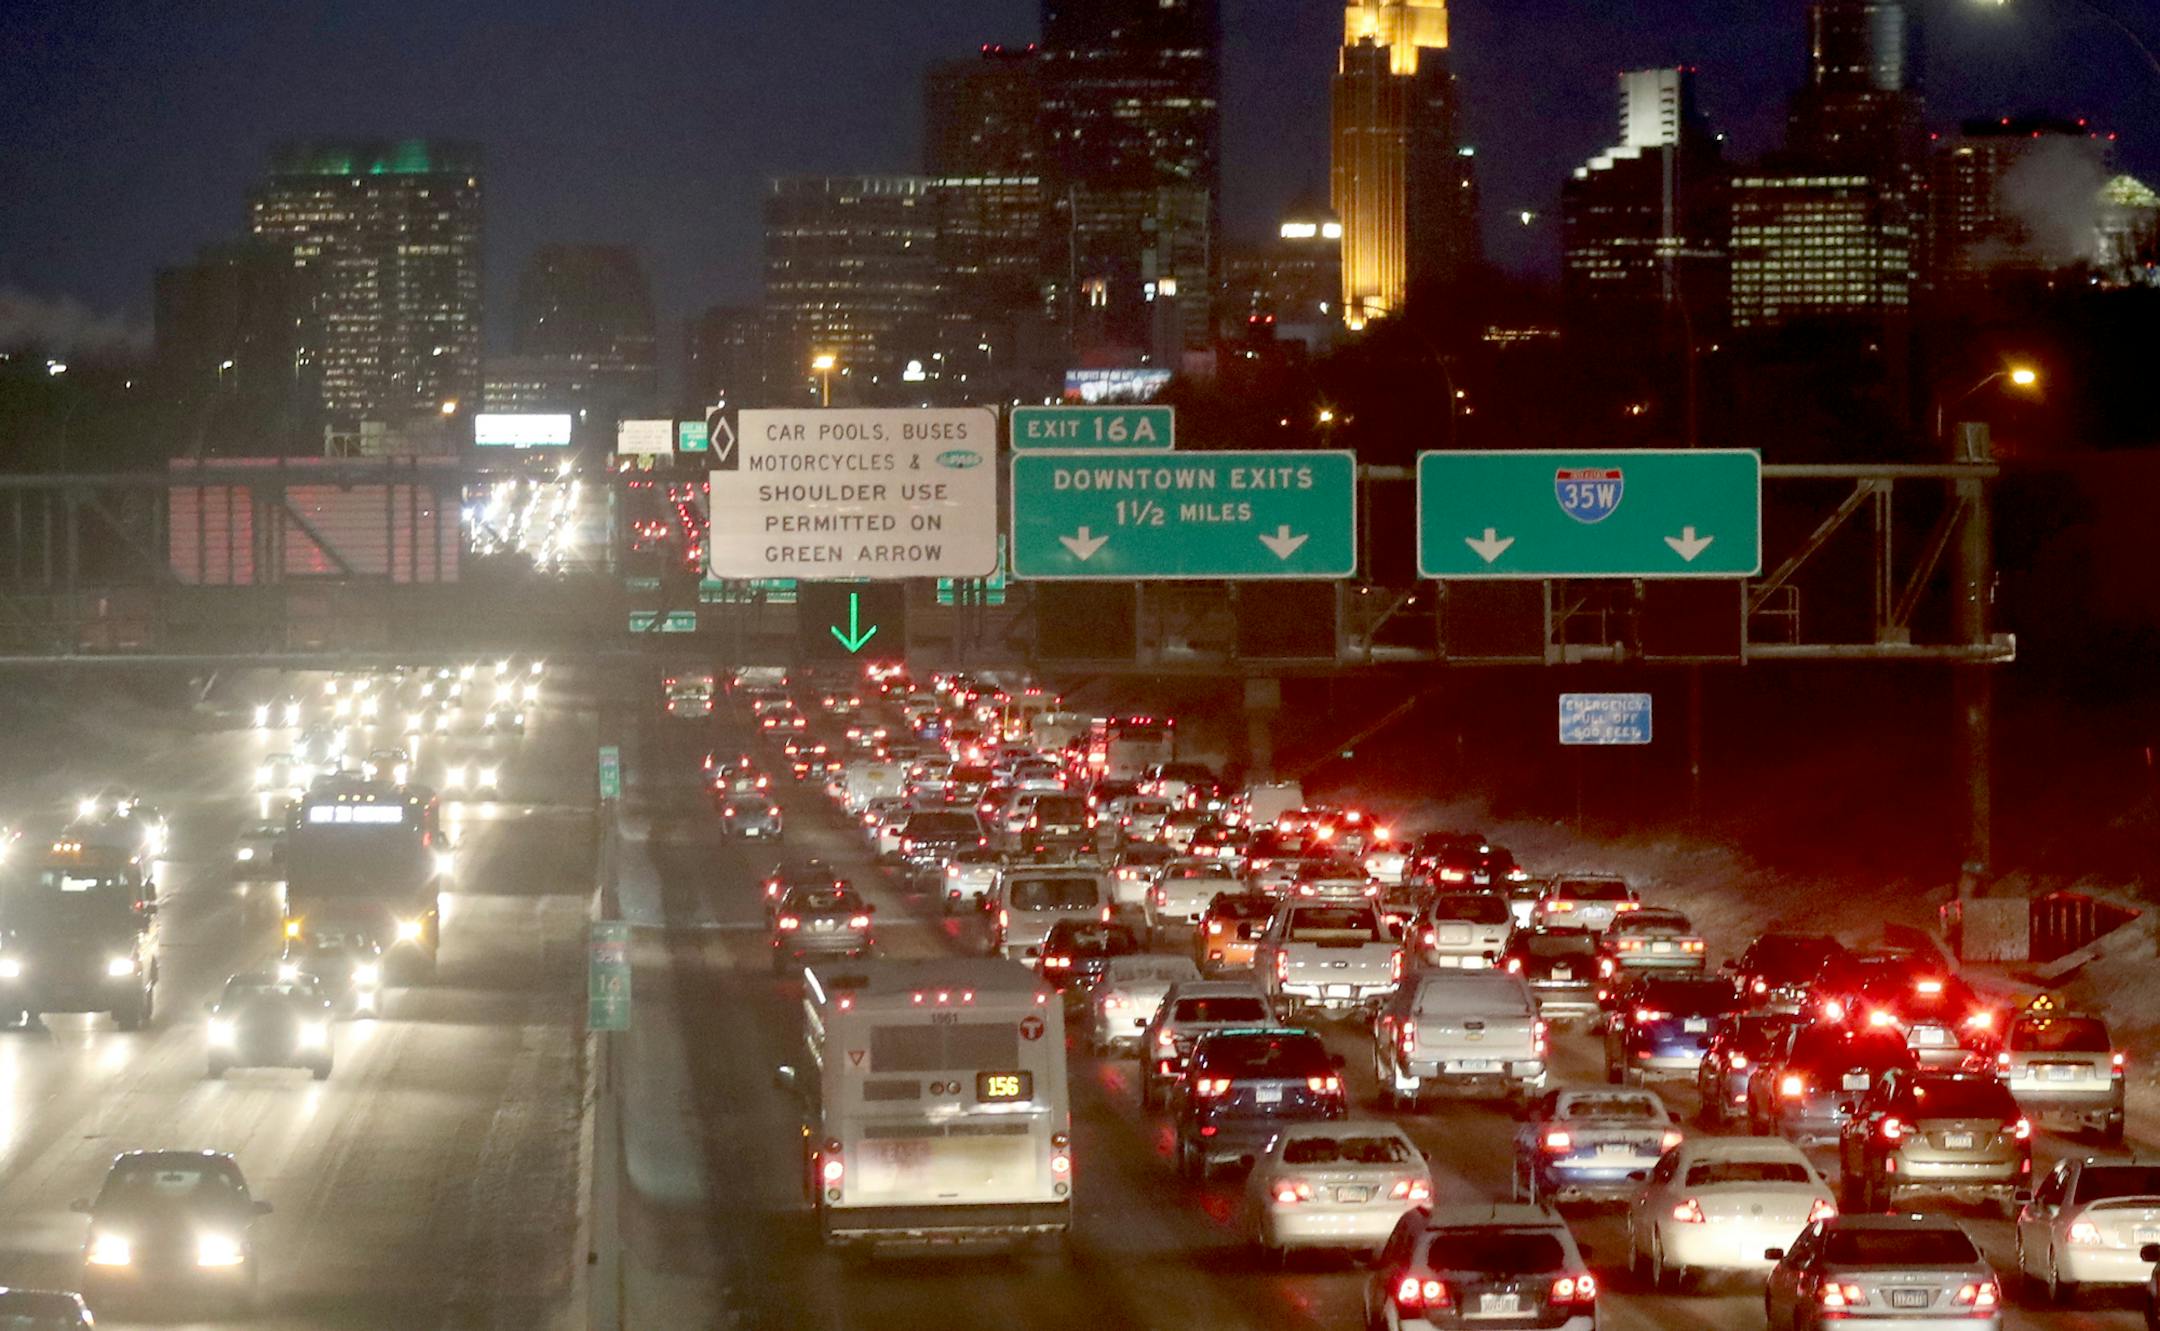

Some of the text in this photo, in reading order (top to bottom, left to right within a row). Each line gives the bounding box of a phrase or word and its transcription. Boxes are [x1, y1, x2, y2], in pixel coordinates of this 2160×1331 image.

[766, 423, 969, 442] CAR POOLS, BUSES
[1027, 417, 1157, 442] EXIT 16A
[749, 454, 895, 472] MOTORCYCLES
[908, 454, 921, 471] &
[1054, 468, 1313, 491] DOWNTOWN EXITS
[759, 484, 948, 502] SHOULDER USE
[1564, 483, 1616, 509] 35W
[1180, 503, 1252, 522] MILES
[765, 515, 943, 532] PERMITTED ON
[765, 545, 943, 563] GREEN ARROW
[1566, 700, 1644, 711] EMERGENCY
[1613, 713, 1638, 724] OFF
[988, 1076, 1019, 1097] 156
